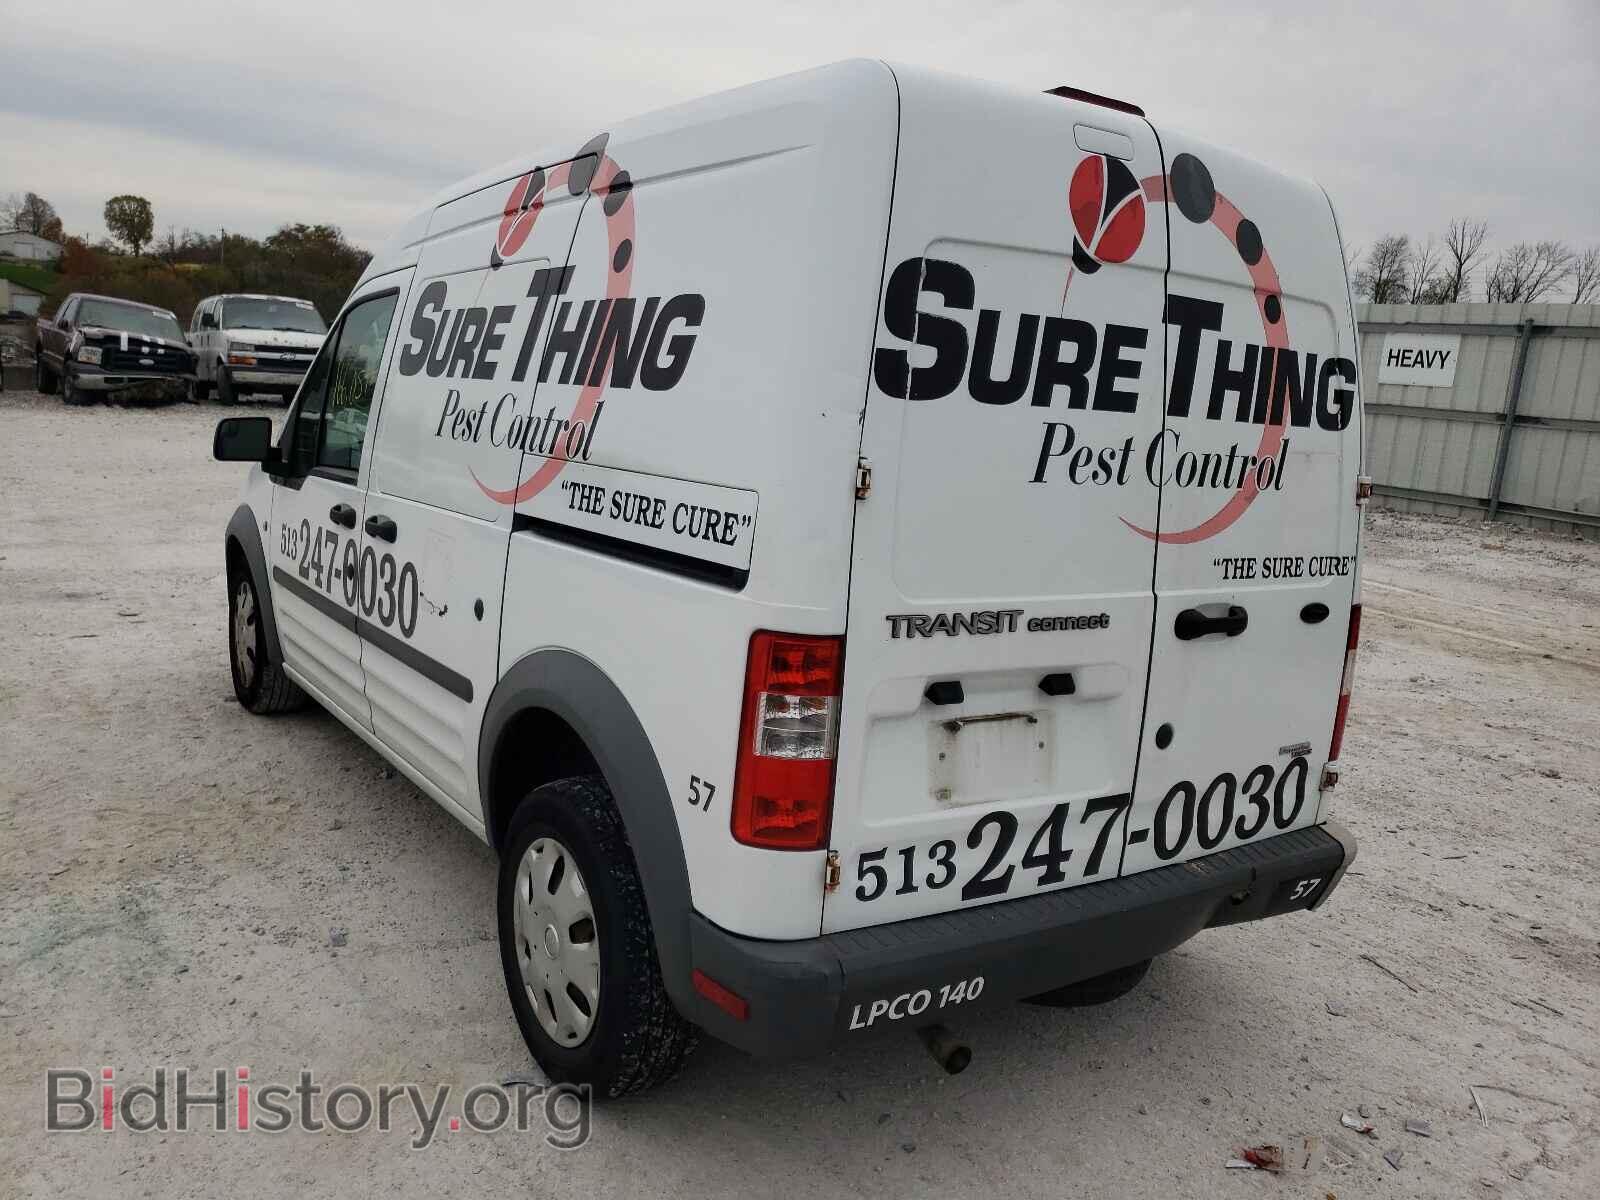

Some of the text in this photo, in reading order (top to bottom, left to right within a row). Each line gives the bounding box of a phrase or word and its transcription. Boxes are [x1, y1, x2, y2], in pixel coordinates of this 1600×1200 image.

[399, 265, 706, 392] SURE THING
[874, 256, 1356, 432] SURE THING
[1386, 348, 1452, 370] HEAVY
[434, 388, 606, 462] Pest Control
[1028, 421, 1291, 491] Pest Control
[609, 490, 667, 530] SURE
[280, 518, 419, 639] 513 247-0030
[1261, 556, 1304, 579] SURE
[886, 609, 1111, 639] TRANSIT connect
[688, 774, 716, 812] 57
[855, 756, 1309, 902] 513 247-0030
[1290, 878, 1322, 900] 57
[849, 976, 985, 1031] LPCO 140
